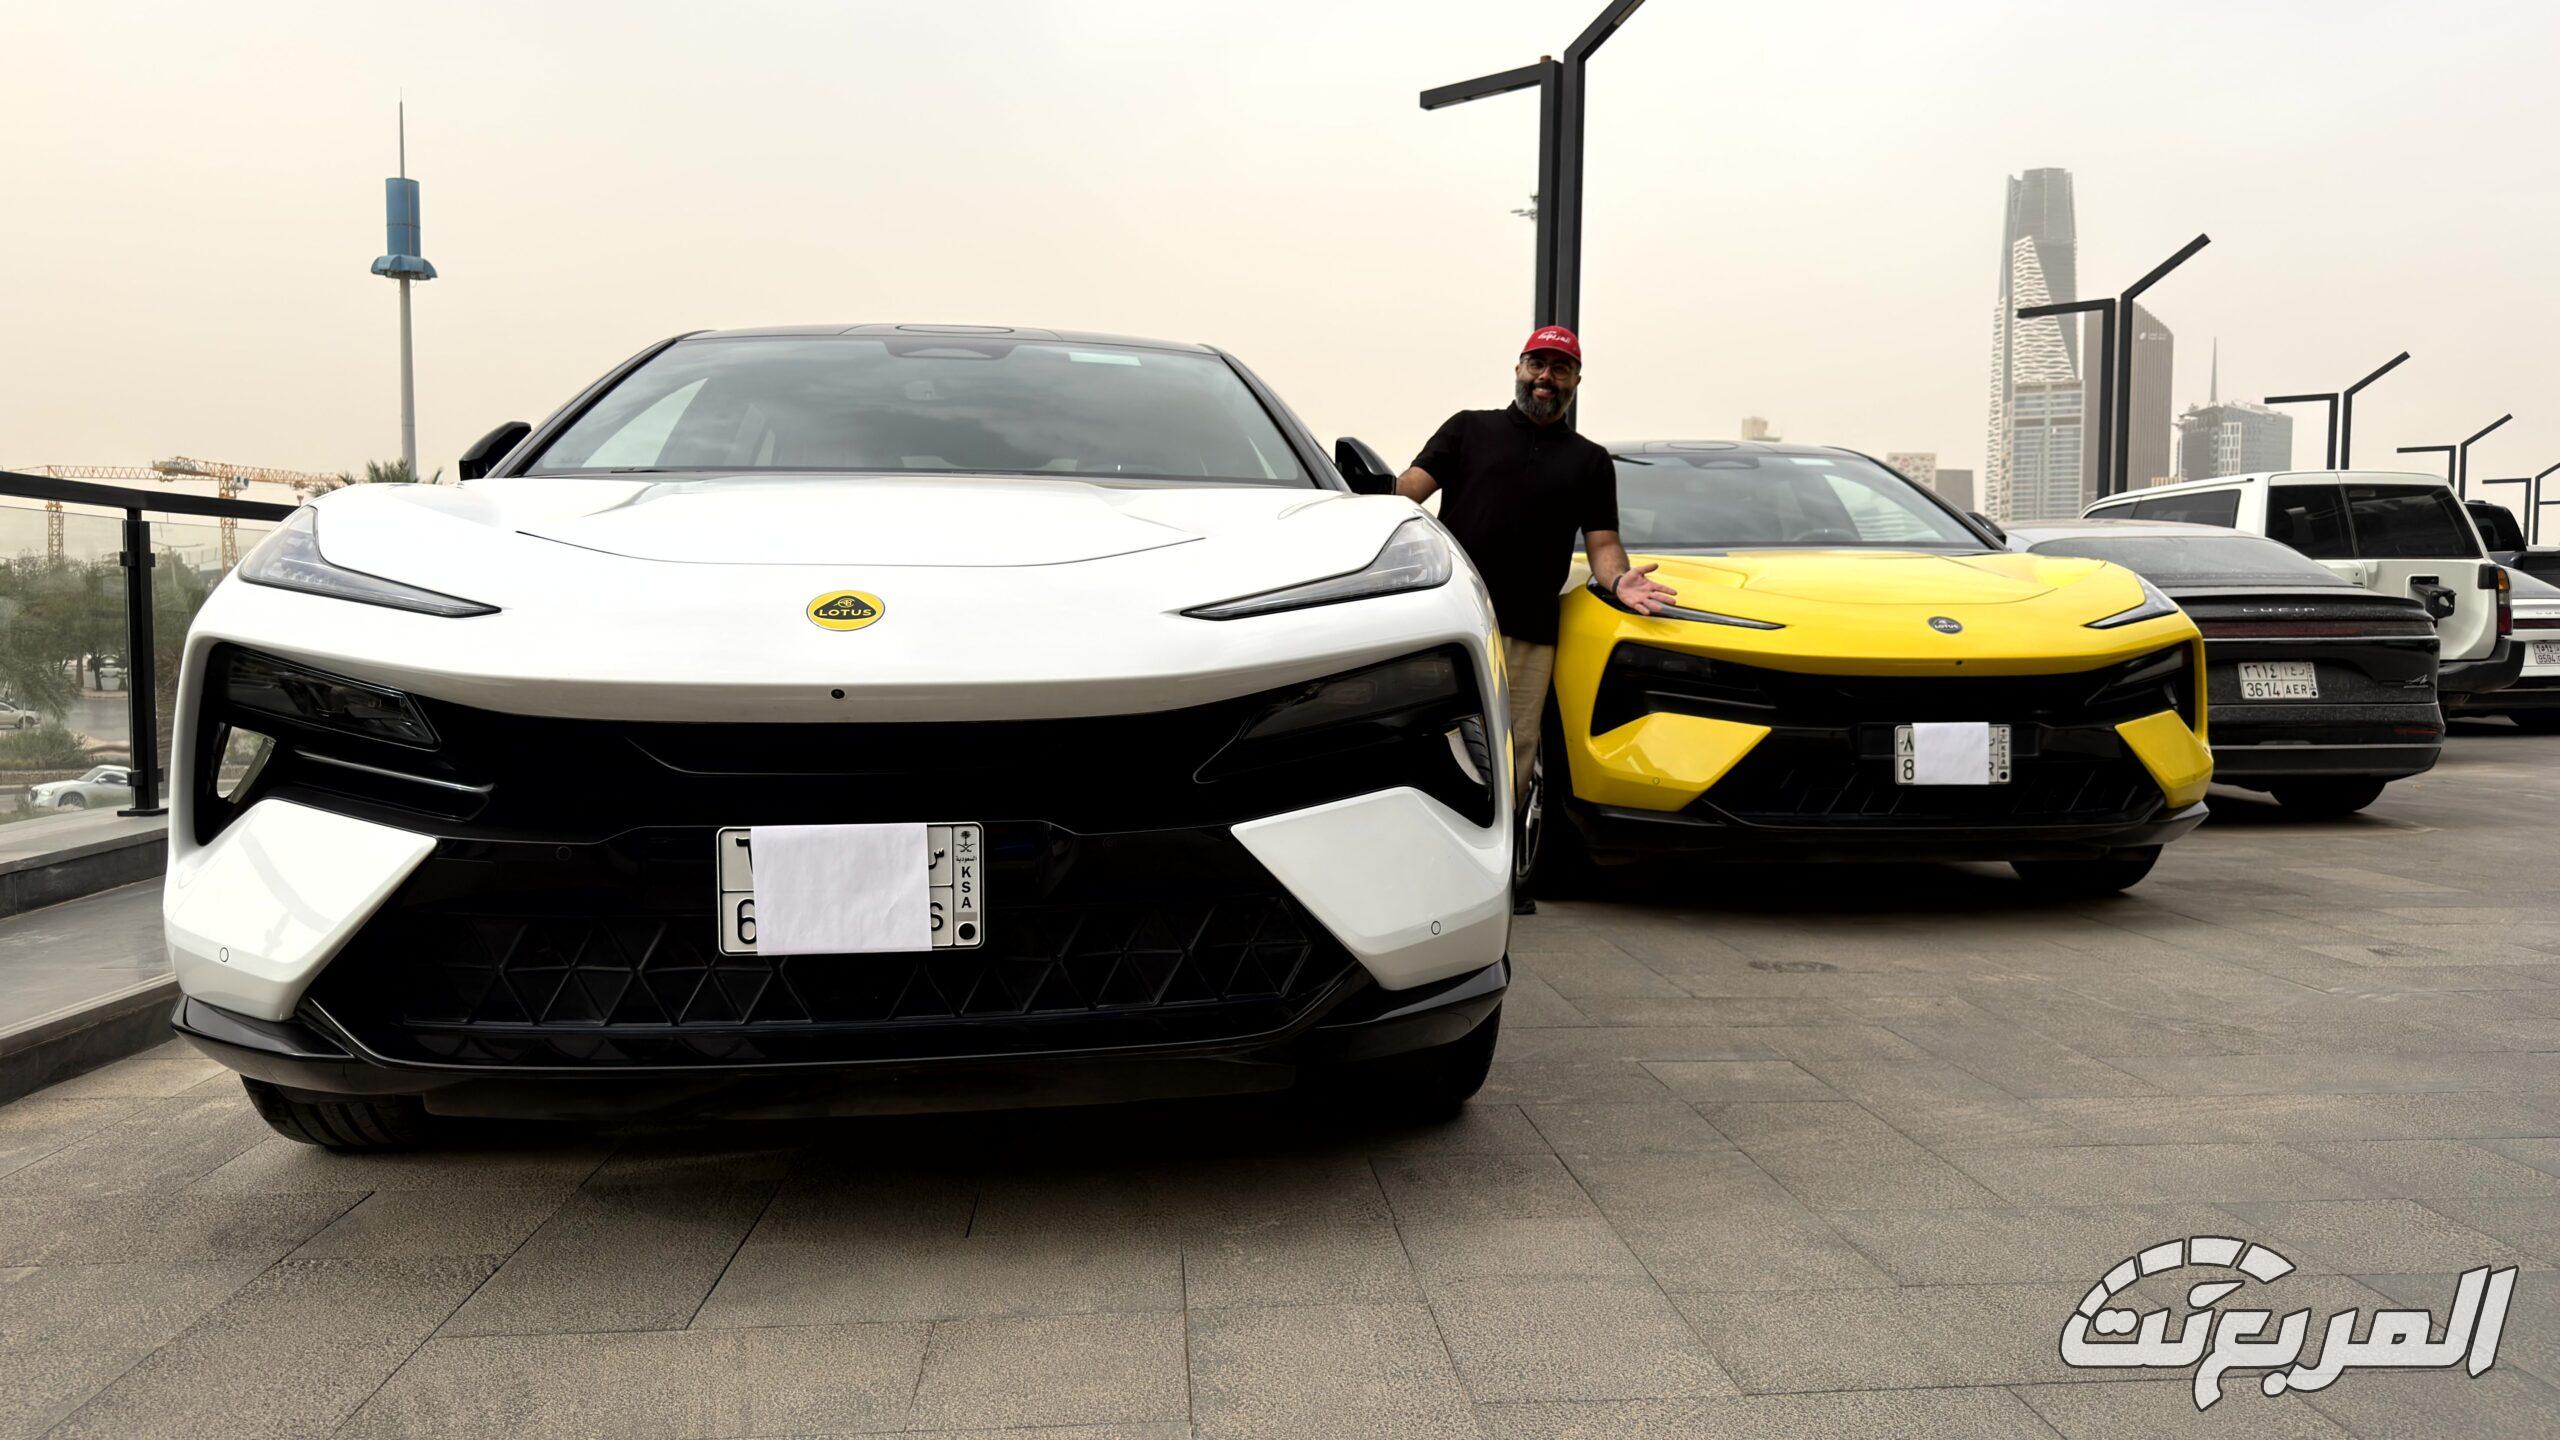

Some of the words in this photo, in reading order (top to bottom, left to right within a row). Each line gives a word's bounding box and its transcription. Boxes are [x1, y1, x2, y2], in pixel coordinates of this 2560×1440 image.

[2246, 682, 2280, 697] 3614
[2285, 684, 2308, 695] AER
[1903, 759, 1915, 781] 8
